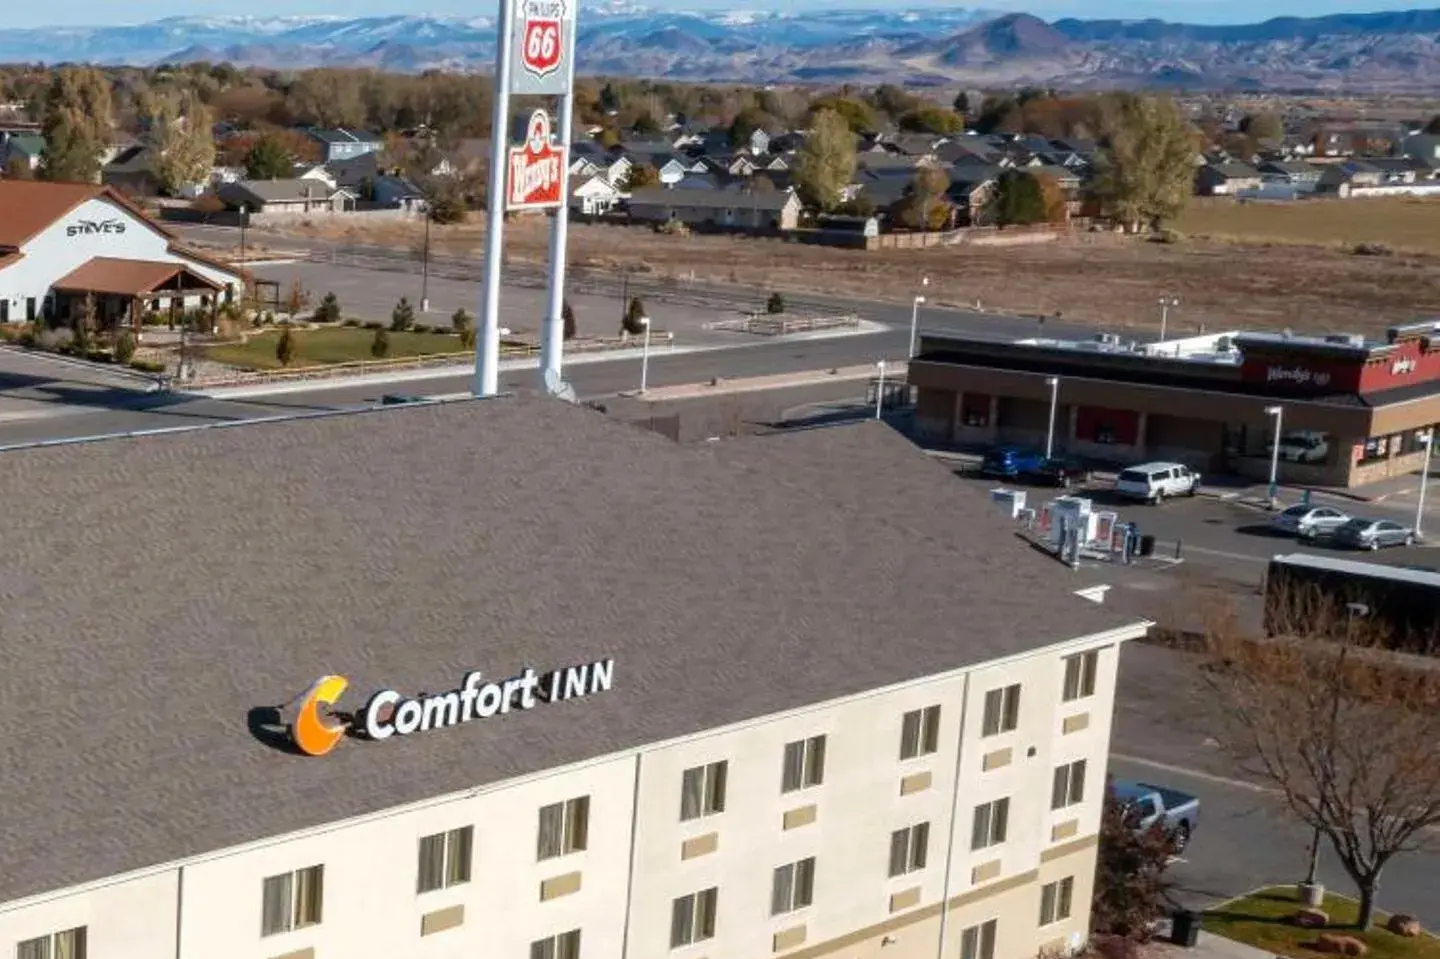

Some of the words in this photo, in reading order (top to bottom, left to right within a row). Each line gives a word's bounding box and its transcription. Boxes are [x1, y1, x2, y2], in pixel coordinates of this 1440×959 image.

[528, 26, 557, 59] 66
[366, 668, 538, 739] Comfort
[550, 660, 614, 702] INN
